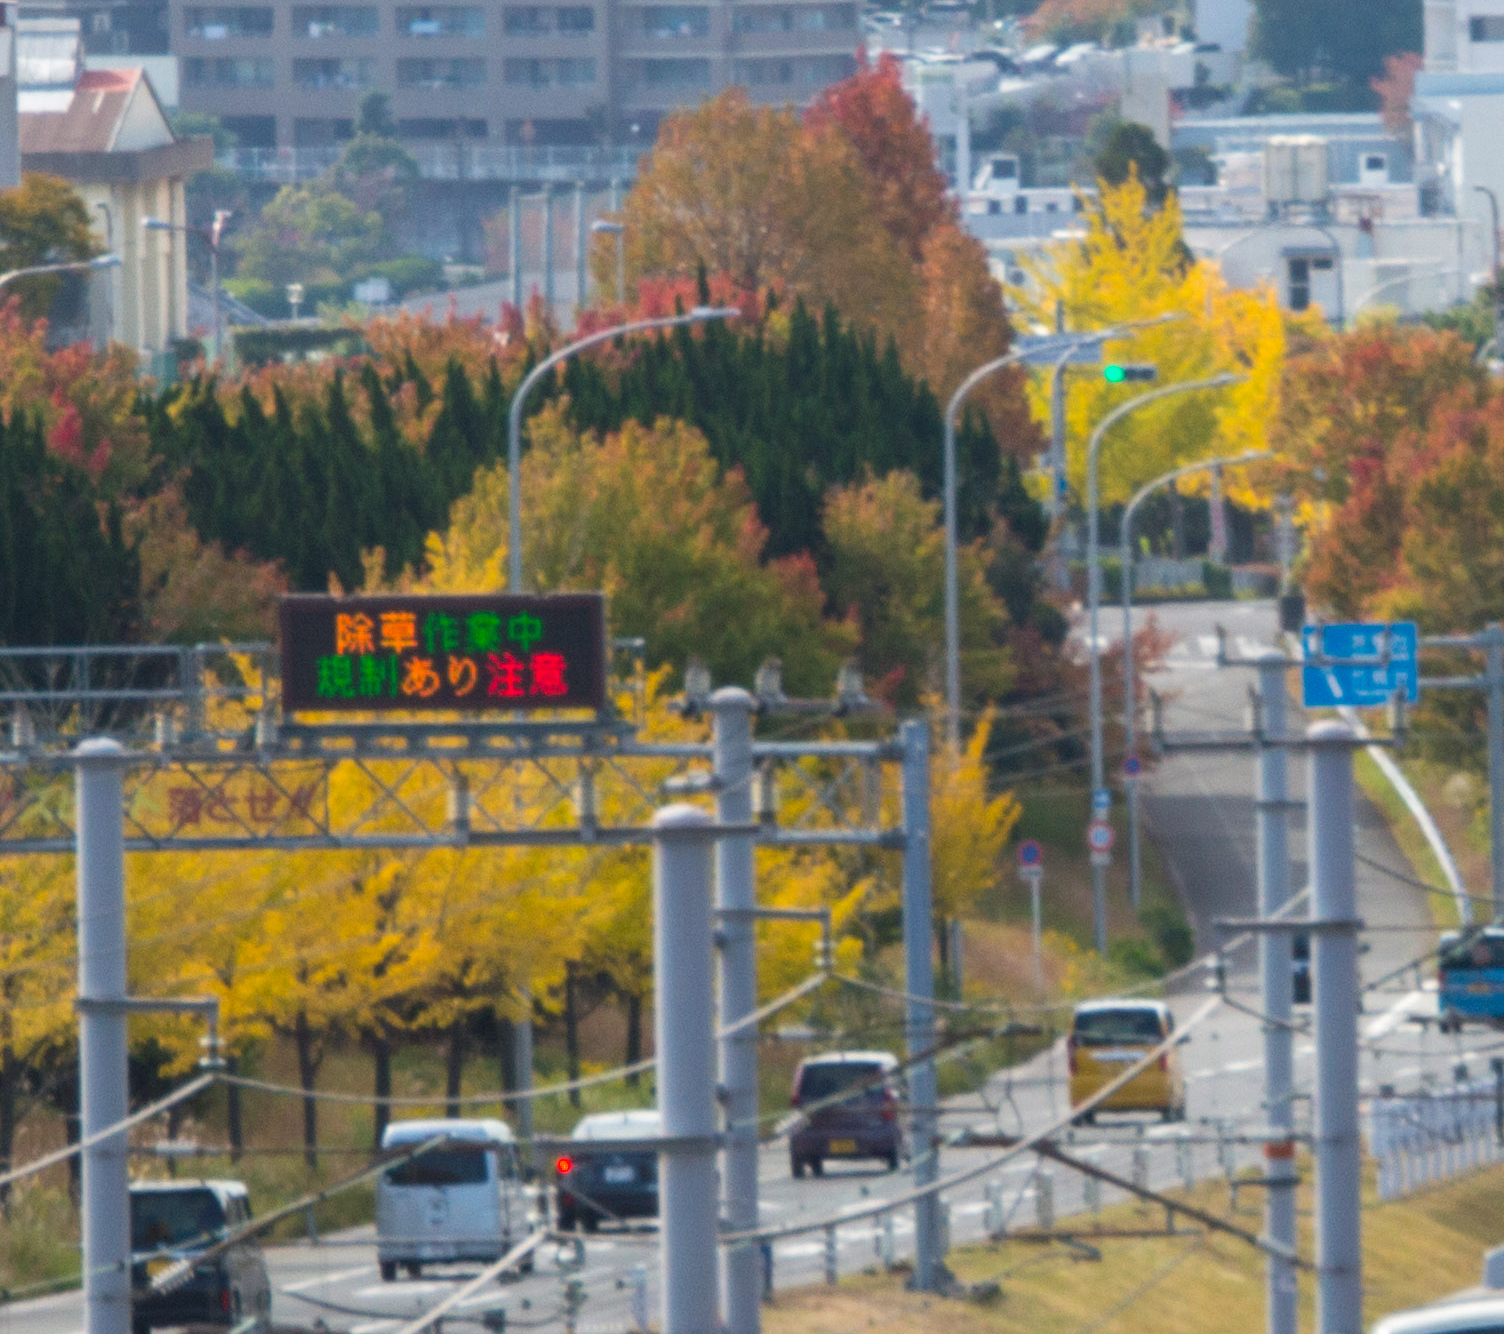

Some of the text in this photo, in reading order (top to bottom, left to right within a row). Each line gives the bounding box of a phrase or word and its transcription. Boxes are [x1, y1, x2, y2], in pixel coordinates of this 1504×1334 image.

[334, 611, 544, 654] 除草作業中
[316, 652, 568, 699] 規制あり注意
